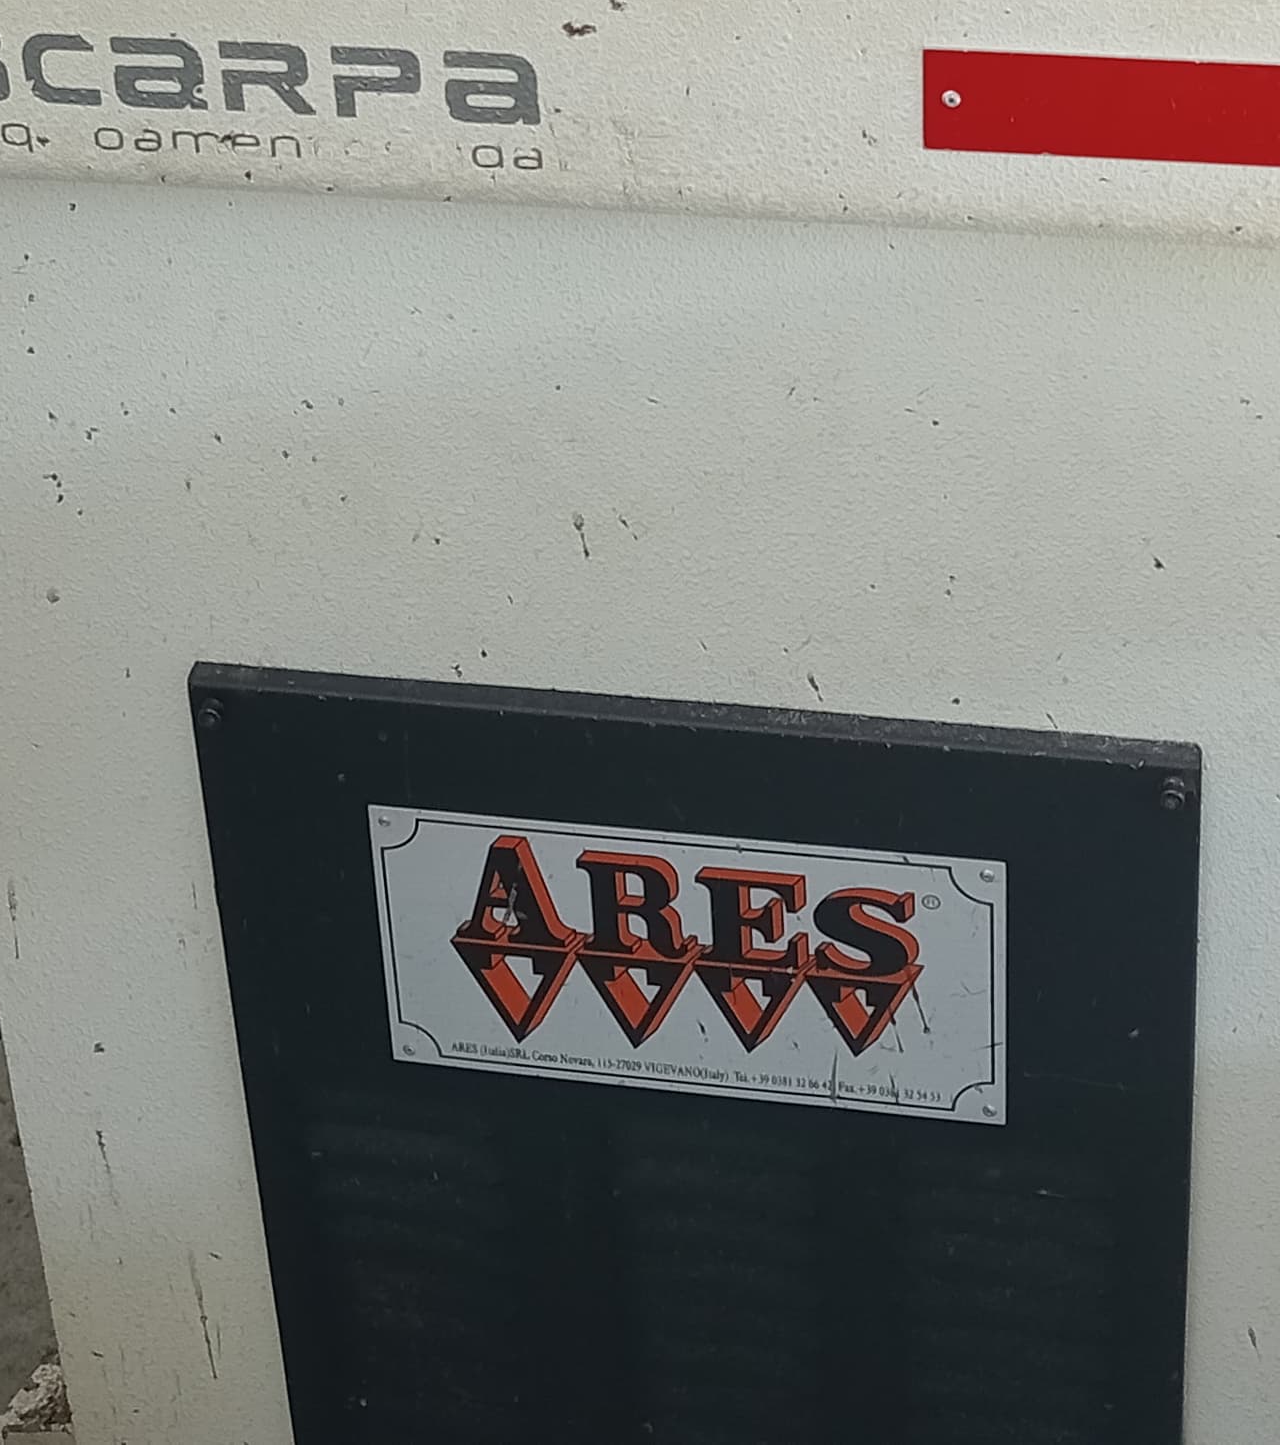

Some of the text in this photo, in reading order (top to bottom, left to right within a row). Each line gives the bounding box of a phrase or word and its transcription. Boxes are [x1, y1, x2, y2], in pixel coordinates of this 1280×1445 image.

[456, 834, 921, 976] ARES
[451, 1042, 478, 1055] ARES
[532, 1049, 559, 1064] Corso
[772, 1074, 793, 1088] 0381
